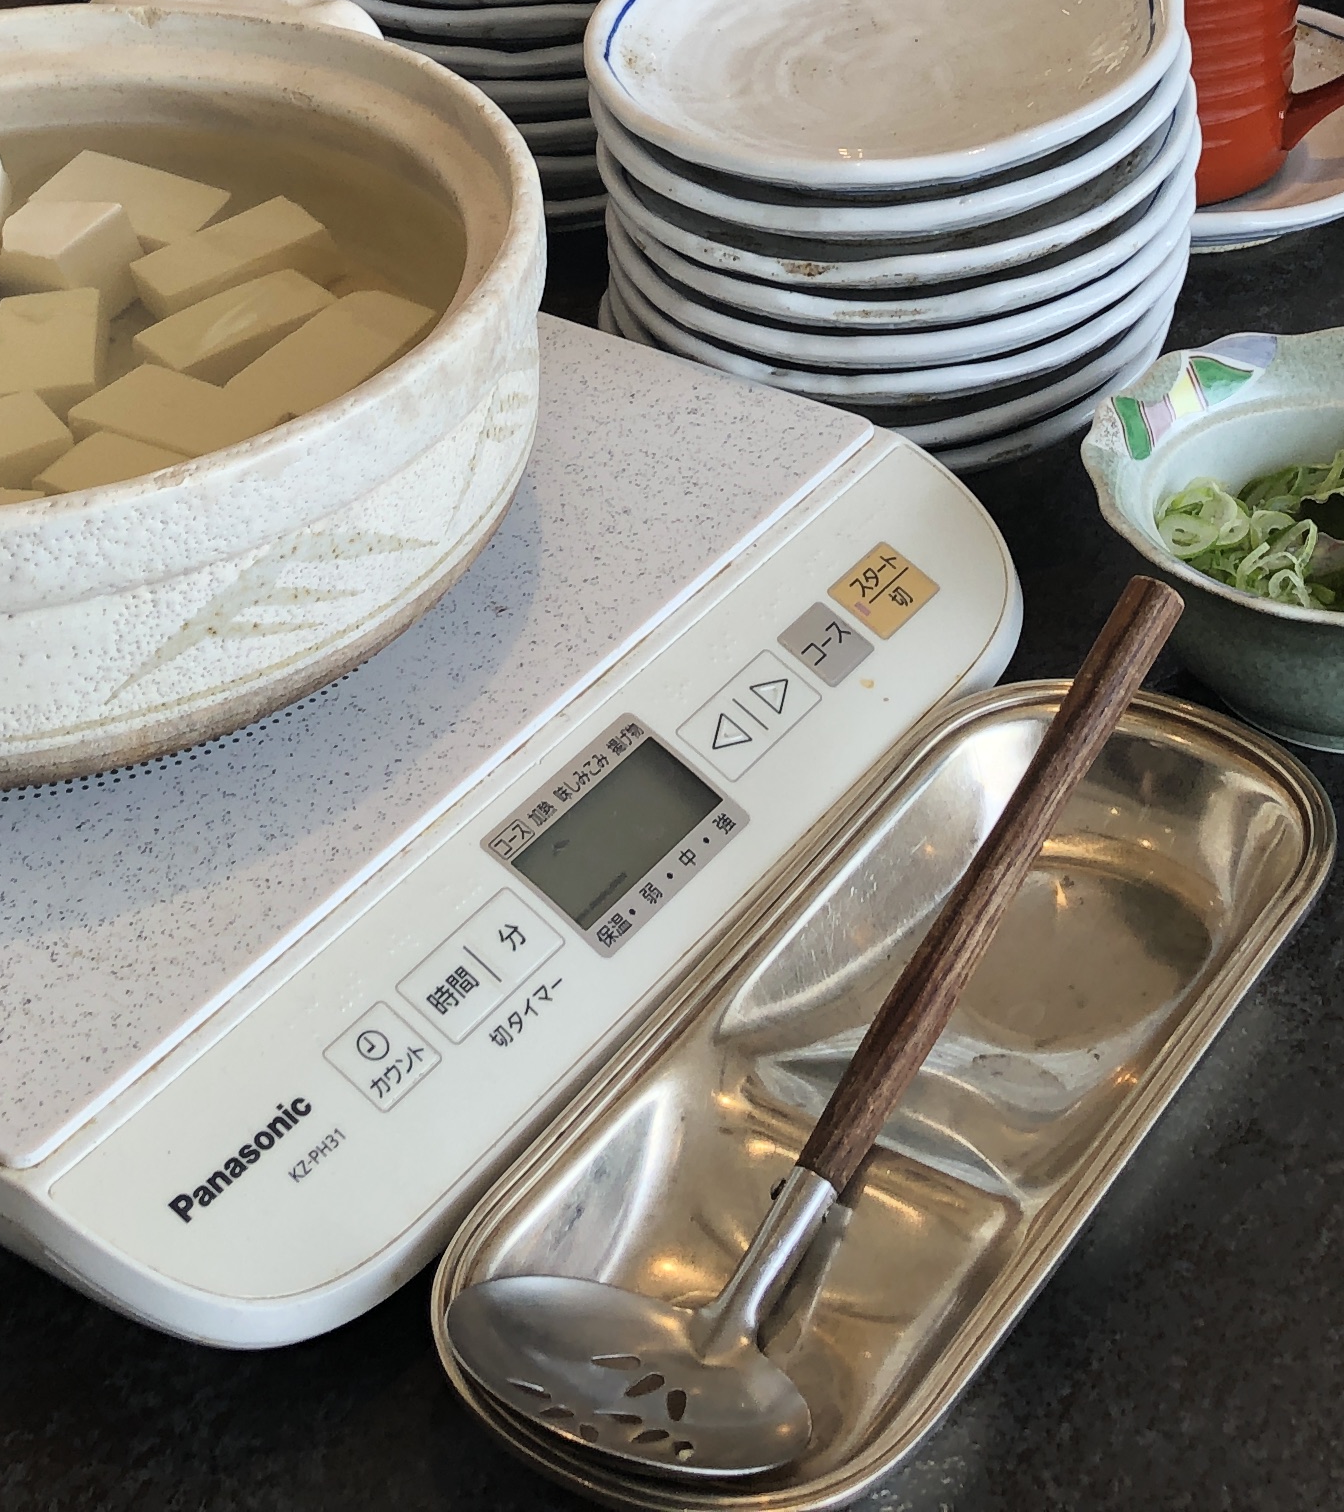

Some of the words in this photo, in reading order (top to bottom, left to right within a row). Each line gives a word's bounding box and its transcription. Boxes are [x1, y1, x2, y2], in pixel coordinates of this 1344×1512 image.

[849, 556, 897, 597] スタート
[888, 586, 914, 606] 切
[801, 621, 851, 666] コース
[493, 824, 531, 855] コース
[553, 754, 610, 802] 味しみこみ
[606, 723, 644, 756] 揚げ物
[426, 966, 480, 1015] 時間
[498, 923, 526, 951] 分
[489, 977, 563, 1049] 切タイマー
[370, 1045, 426, 1098] カウント
[168, 1096, 312, 1223] Panasonic
[288, 1128, 347, 1183] KZ-PH31
